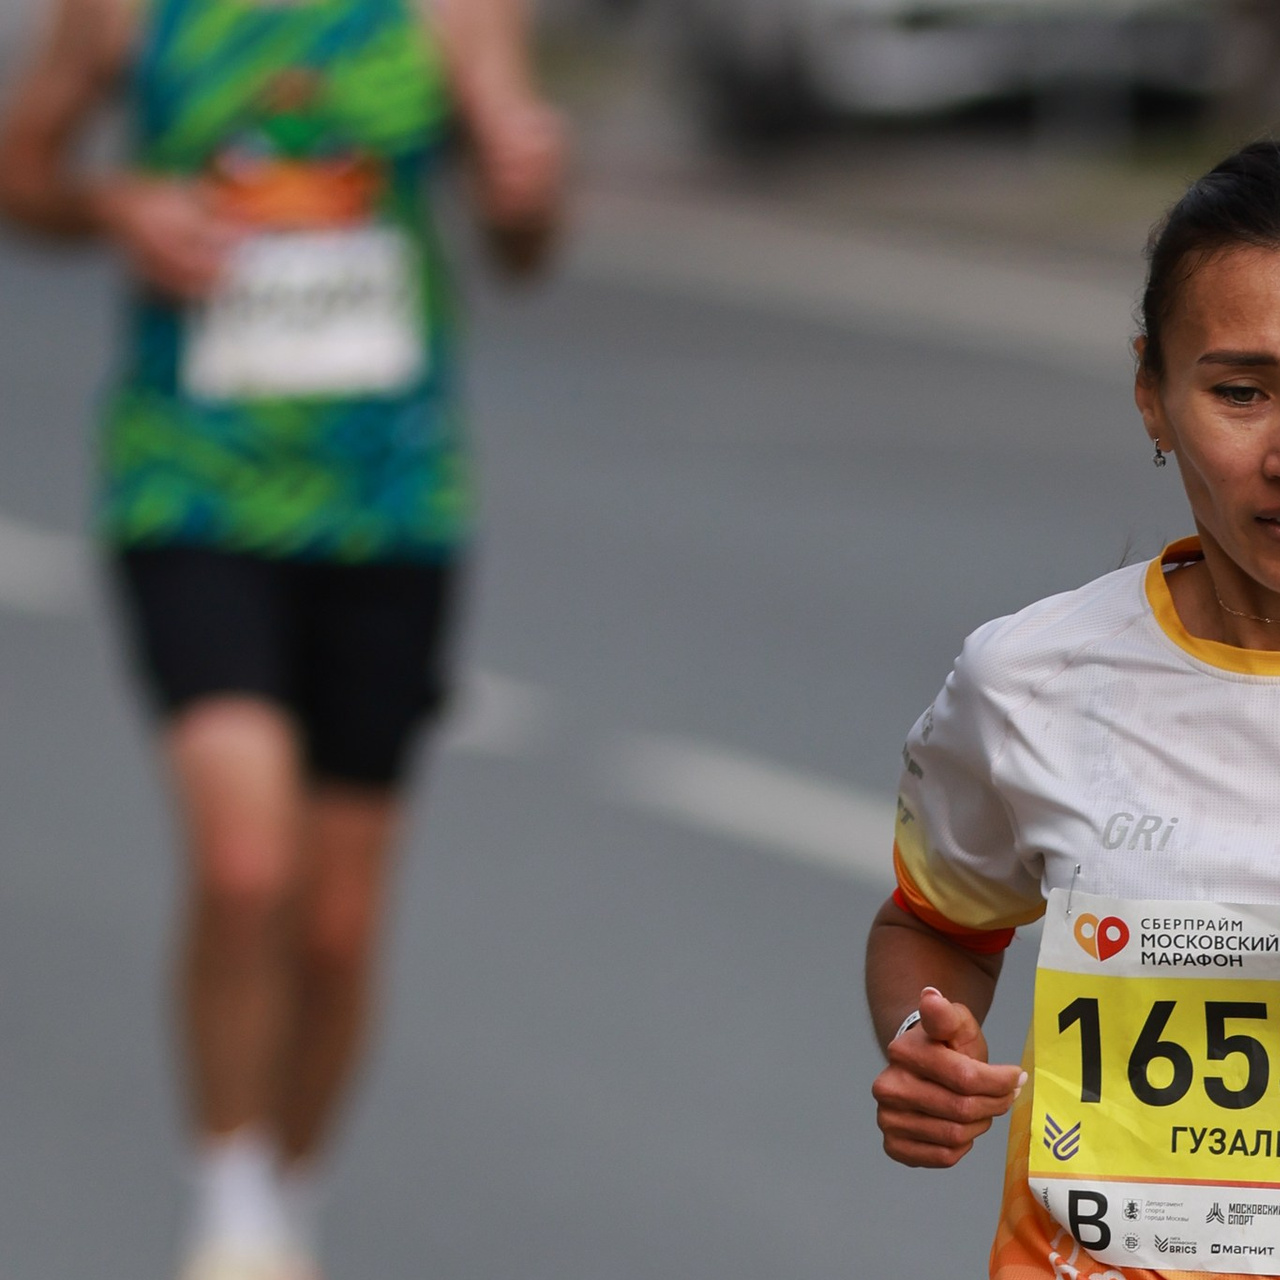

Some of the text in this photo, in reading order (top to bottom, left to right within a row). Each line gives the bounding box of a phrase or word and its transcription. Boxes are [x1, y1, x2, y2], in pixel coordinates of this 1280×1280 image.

[1102, 812, 1179, 851] GRi
[1140, 917, 1243, 932] СБЕРПРАЙМ
[1140, 933, 1280, 952] МОСКОВСКИЙ
[1140, 951, 1243, 968] МАРАФОН
[1228, 1214, 1254, 1226] СПОРТ
[1169, 1245, 1197, 1255] BRICS
